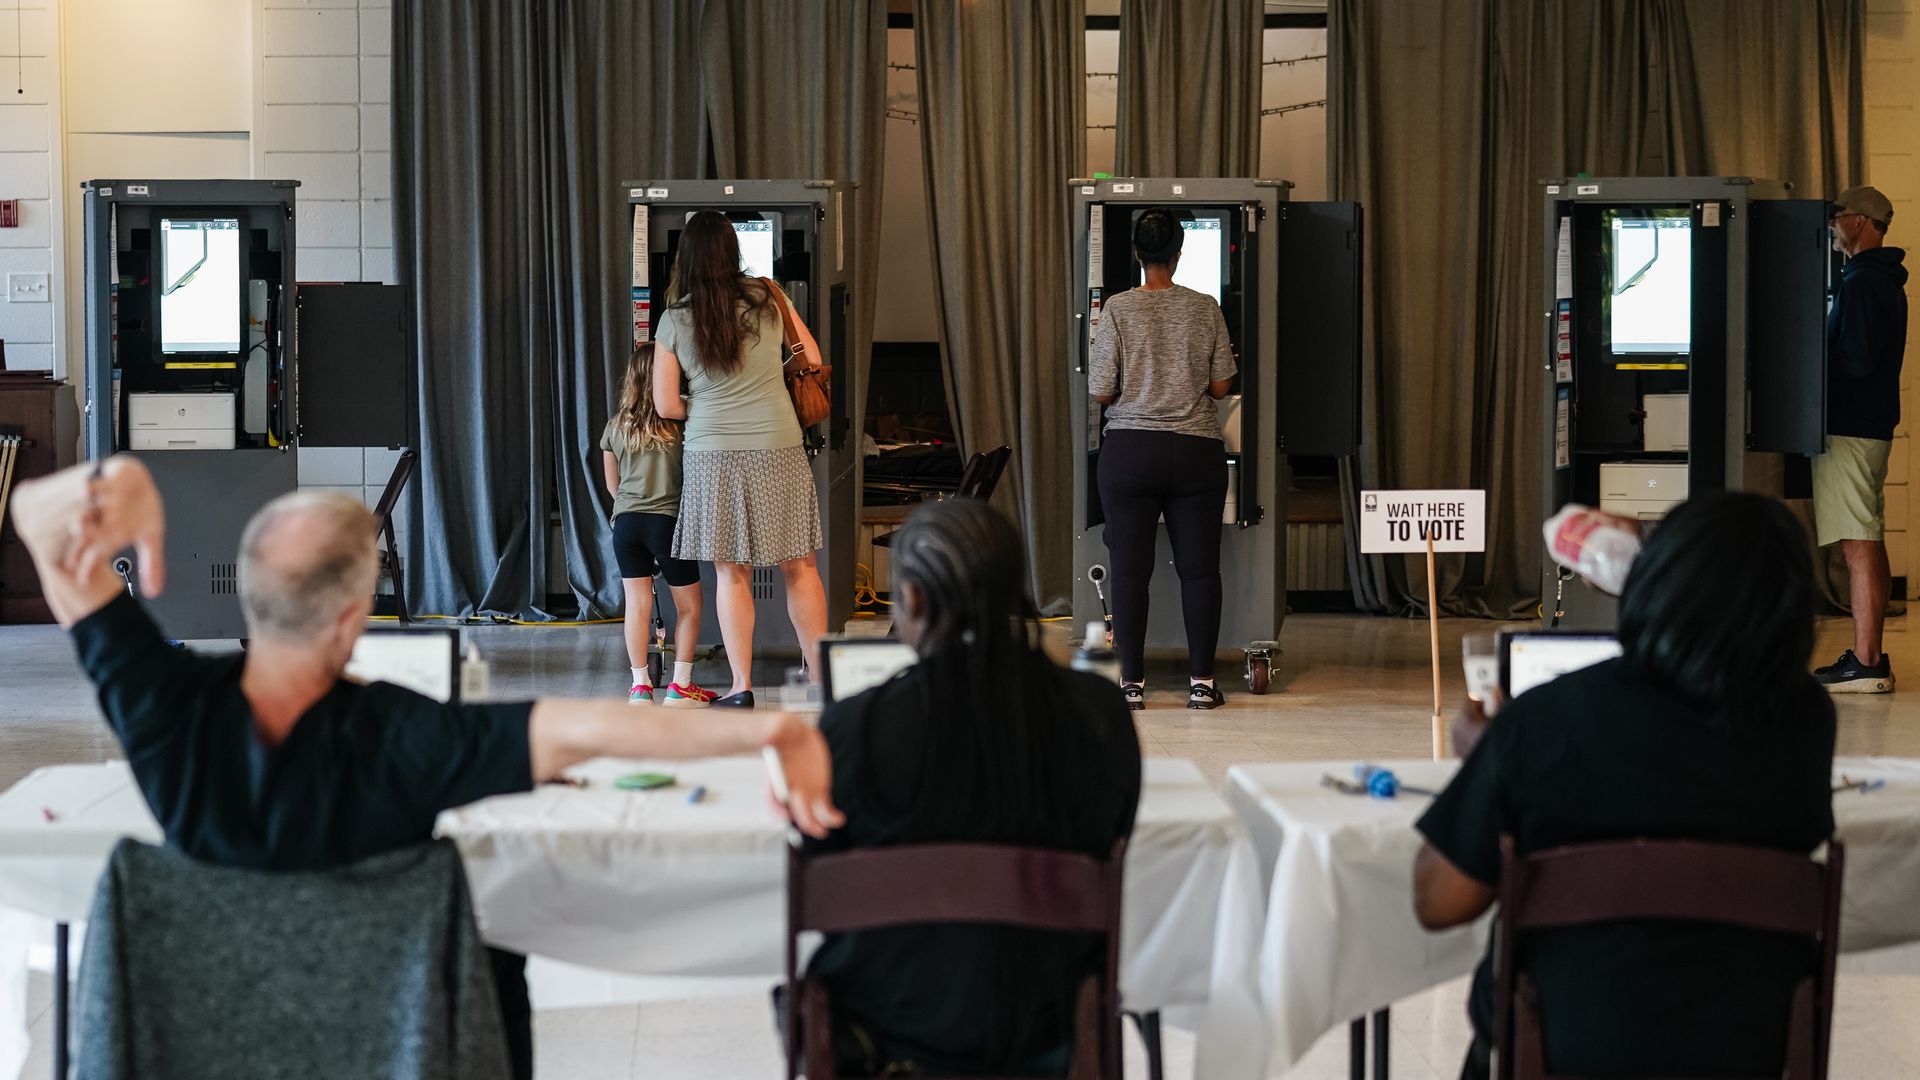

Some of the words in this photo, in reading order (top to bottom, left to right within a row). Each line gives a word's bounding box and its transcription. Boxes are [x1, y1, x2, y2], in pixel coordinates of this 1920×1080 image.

[1387, 503, 1424, 518] WAIT
[1427, 502, 1465, 517] HERE
[1386, 520, 1410, 541] TO
[1417, 519, 1465, 541] VOTE
